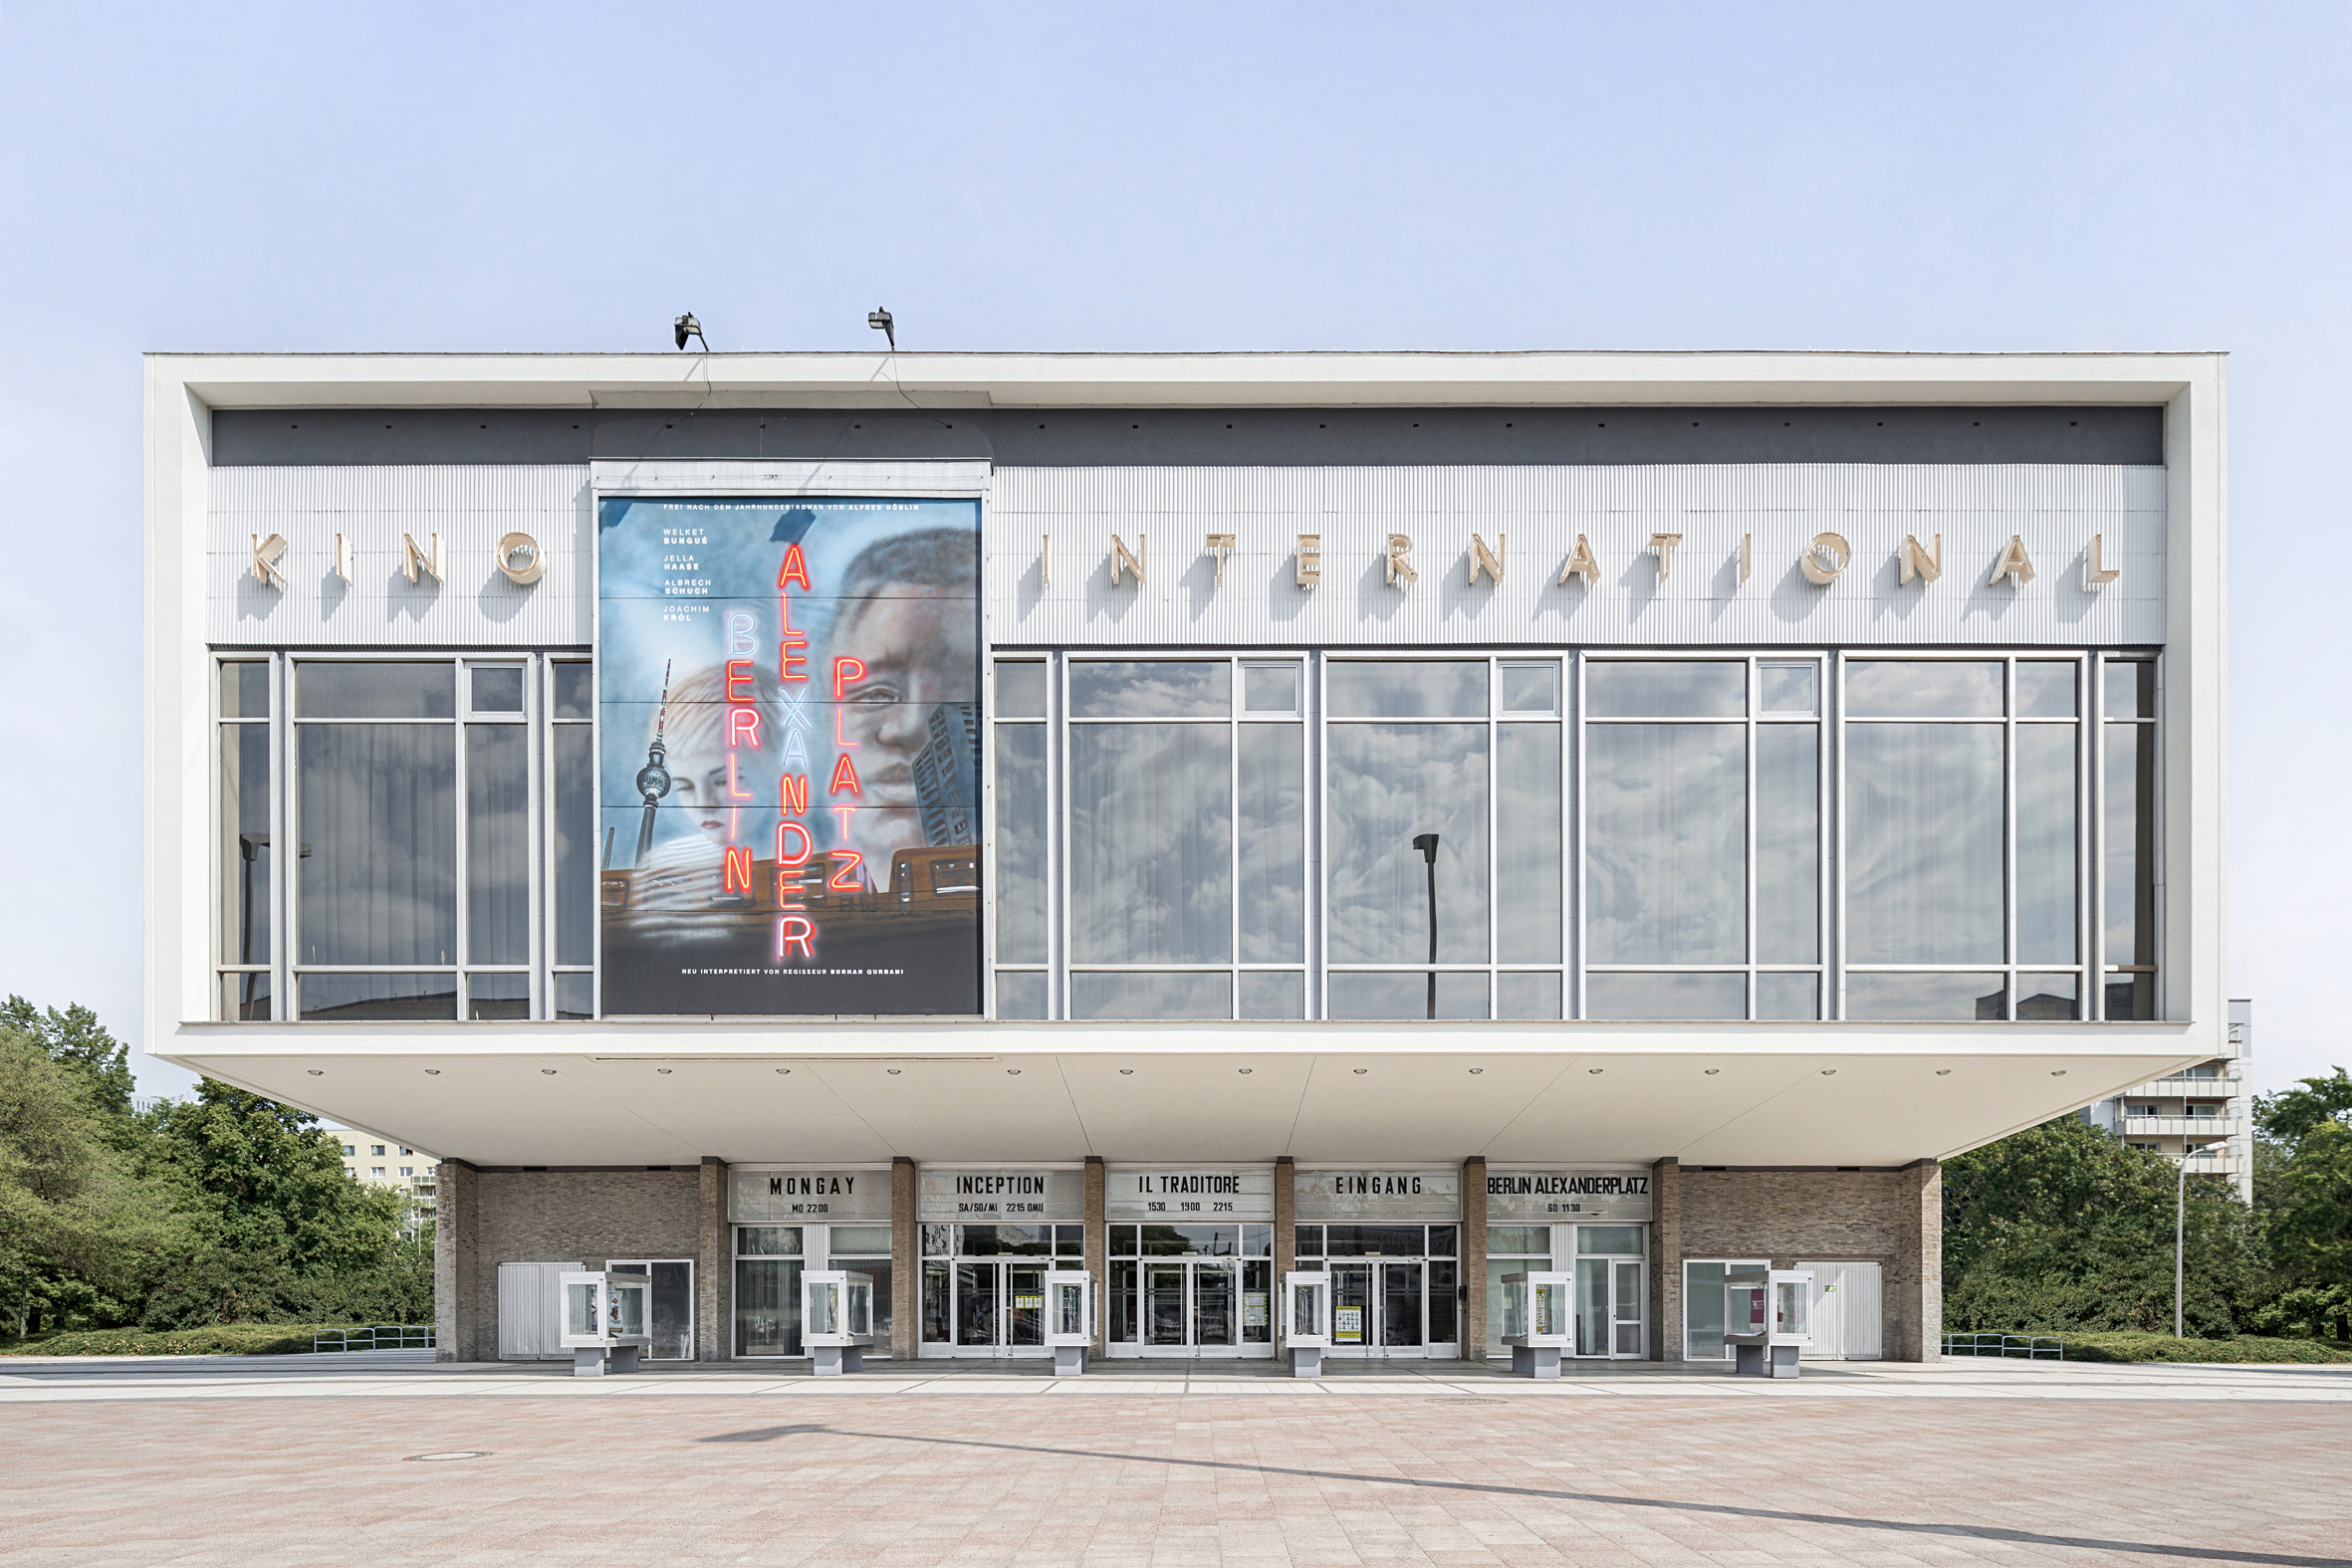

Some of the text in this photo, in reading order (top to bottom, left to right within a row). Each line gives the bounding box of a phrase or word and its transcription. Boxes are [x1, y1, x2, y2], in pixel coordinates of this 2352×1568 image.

[663, 536, 708, 545] BUNGUÉ
[250, 532, 2120, 585] KINO INTERNATIONAL
[663, 612, 692, 621] KRÓL
[725, 612, 761, 894] BERLIN
[777, 544, 817, 959] ALEXANDER
[828, 657, 866, 893] PLATZ
[770, 1177, 855, 1195] MONGAY
[956, 1176, 1045, 1195] INCEPTION
[1138, 1176, 1240, 1194] IL TRADITORE
[1335, 1176, 1422, 1195] EINGANG
[1487, 1176, 1648, 1195] BERLIN ALEXANDERPLATZ
[792, 1203, 828, 1213] MO 2200
[958, 1203, 1044, 1213] SA/SO/MI 2215 OMU
[1147, 1202, 1233, 1212] 1530 1900 2215
[1546, 1203, 1581, 1214] SO 1130
